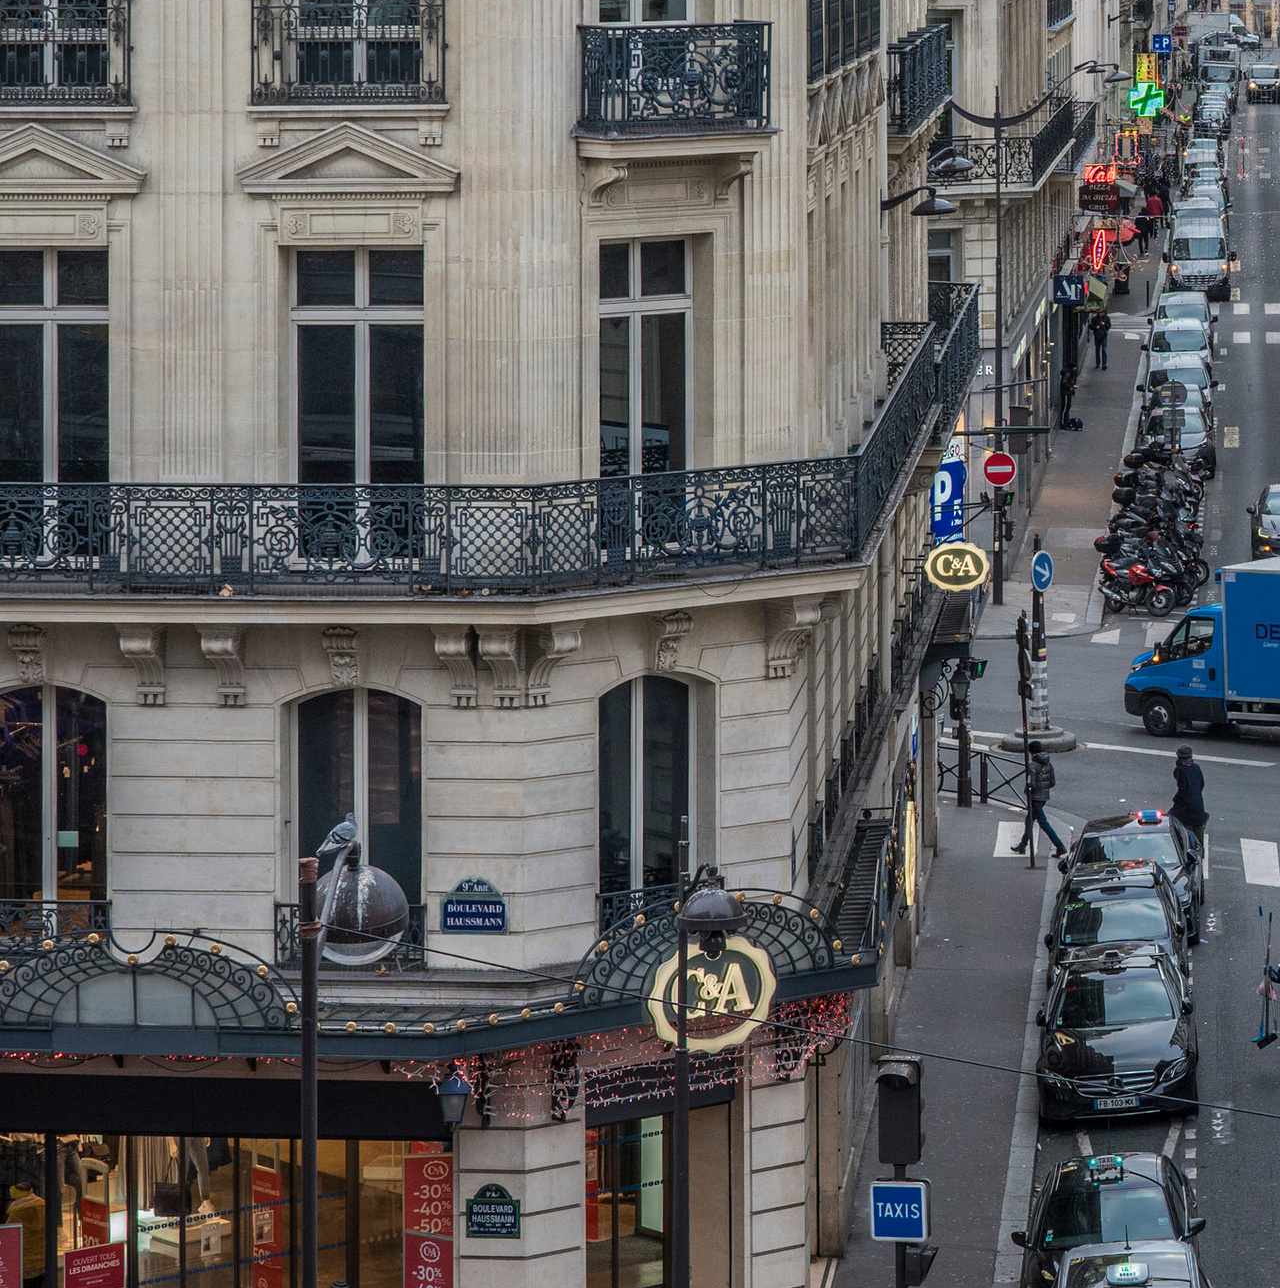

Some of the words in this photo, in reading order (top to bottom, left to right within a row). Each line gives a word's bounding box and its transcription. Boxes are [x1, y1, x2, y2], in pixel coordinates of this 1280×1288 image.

[1162, 38, 1170, 48] P
[936, 554, 978, 577] C&A
[448, 904, 503, 912] BOULEVARD
[447, 917, 502, 926] HAUSSMANN
[671, 962, 754, 1019] C&A
[428, 1165, 444, 1176] C&A
[414, 1183, 451, 1199] -30%
[414, 1200, 451, 1216] -40%
[473, 1205, 513, 1213] BOULEVARD
[876, 1202, 920, 1219] TAXIS
[414, 1218, 451, 1233] -50%
[73, 1254, 98, 1266] OUVERT
[99, 1252, 116, 1261] TOUS
[423, 1246, 437, 1258] C&A
[69, 1265, 81, 1275] LES
[82, 1259, 120, 1273] DIMANCHES
[412, 1265, 442, 1282] -30%
